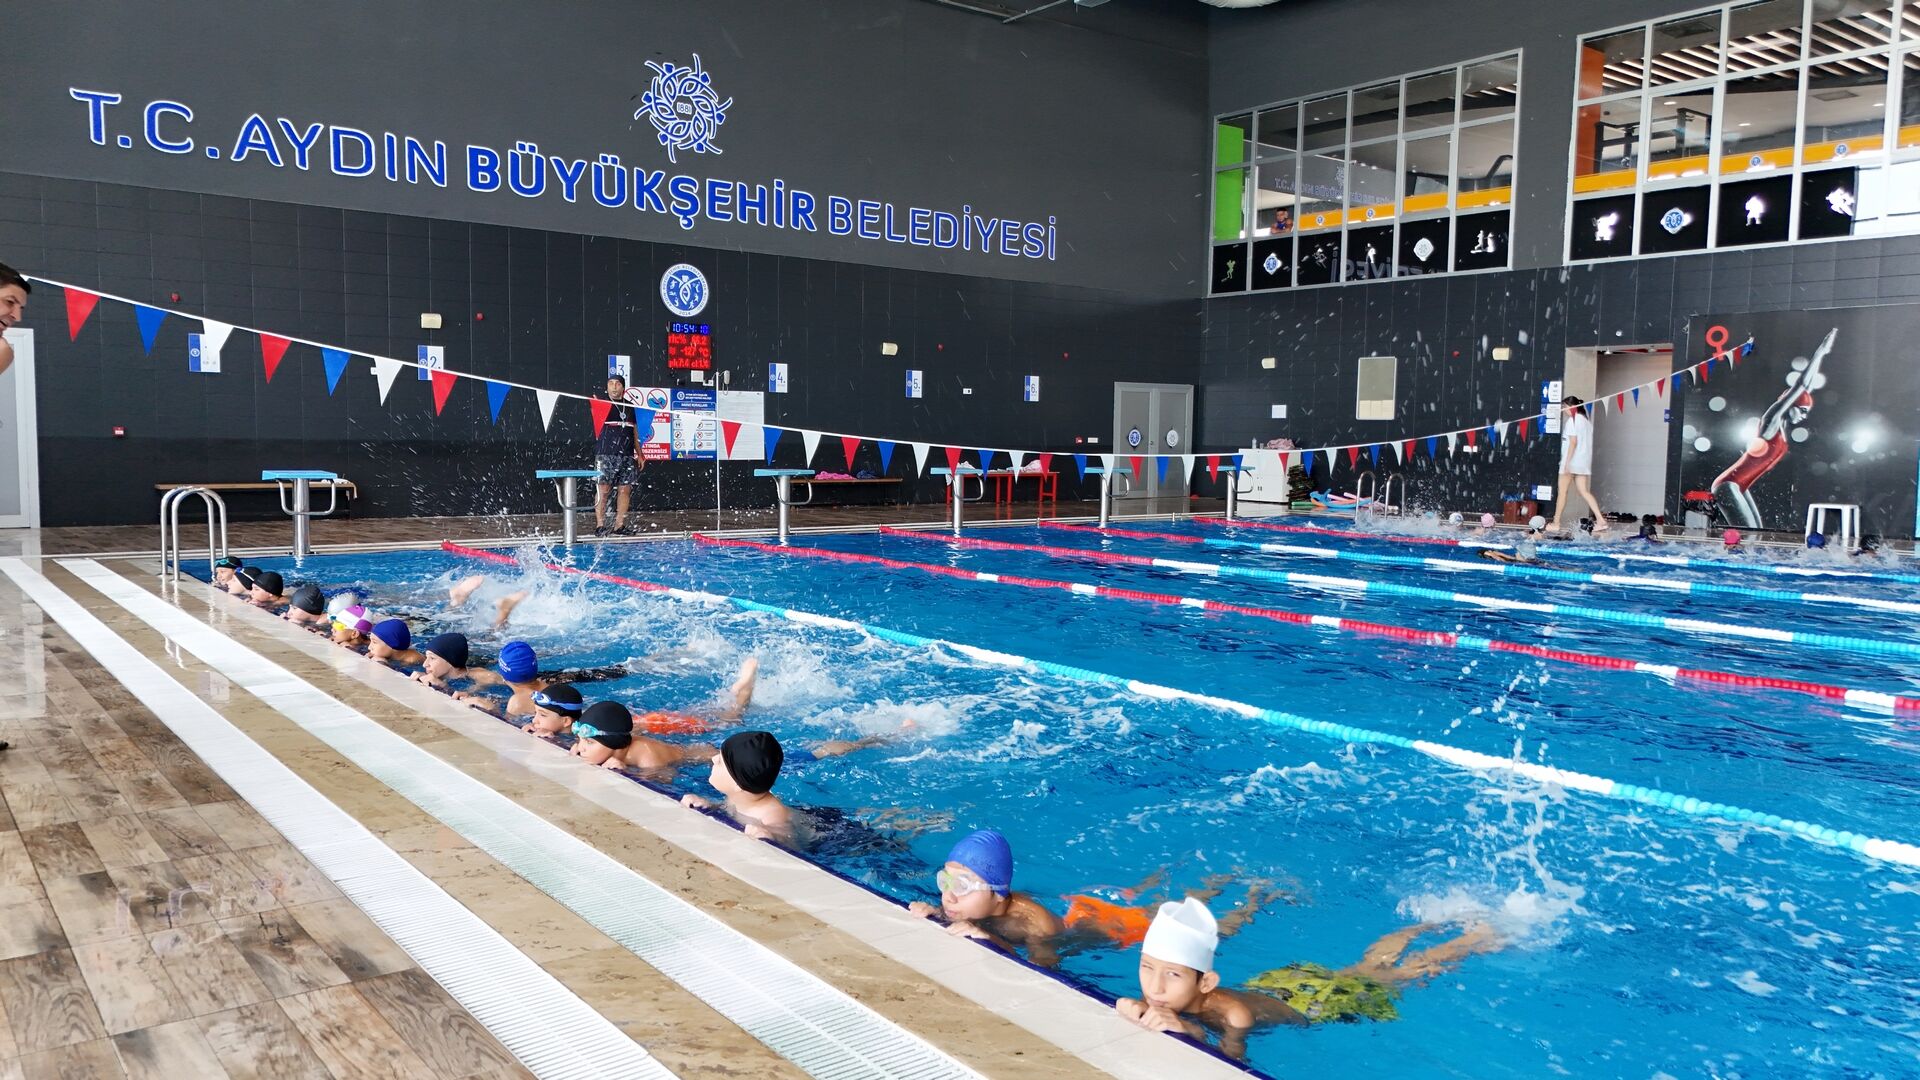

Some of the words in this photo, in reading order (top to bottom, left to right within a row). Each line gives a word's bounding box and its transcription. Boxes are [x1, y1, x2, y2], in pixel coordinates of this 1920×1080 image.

[676, 102, 693, 115] 1881
[231, 113, 448, 188] AYDIN
[466, 141, 818, 230] BÜYÜKŞEHİR
[828, 195, 1057, 262] BELEDİYESİ
